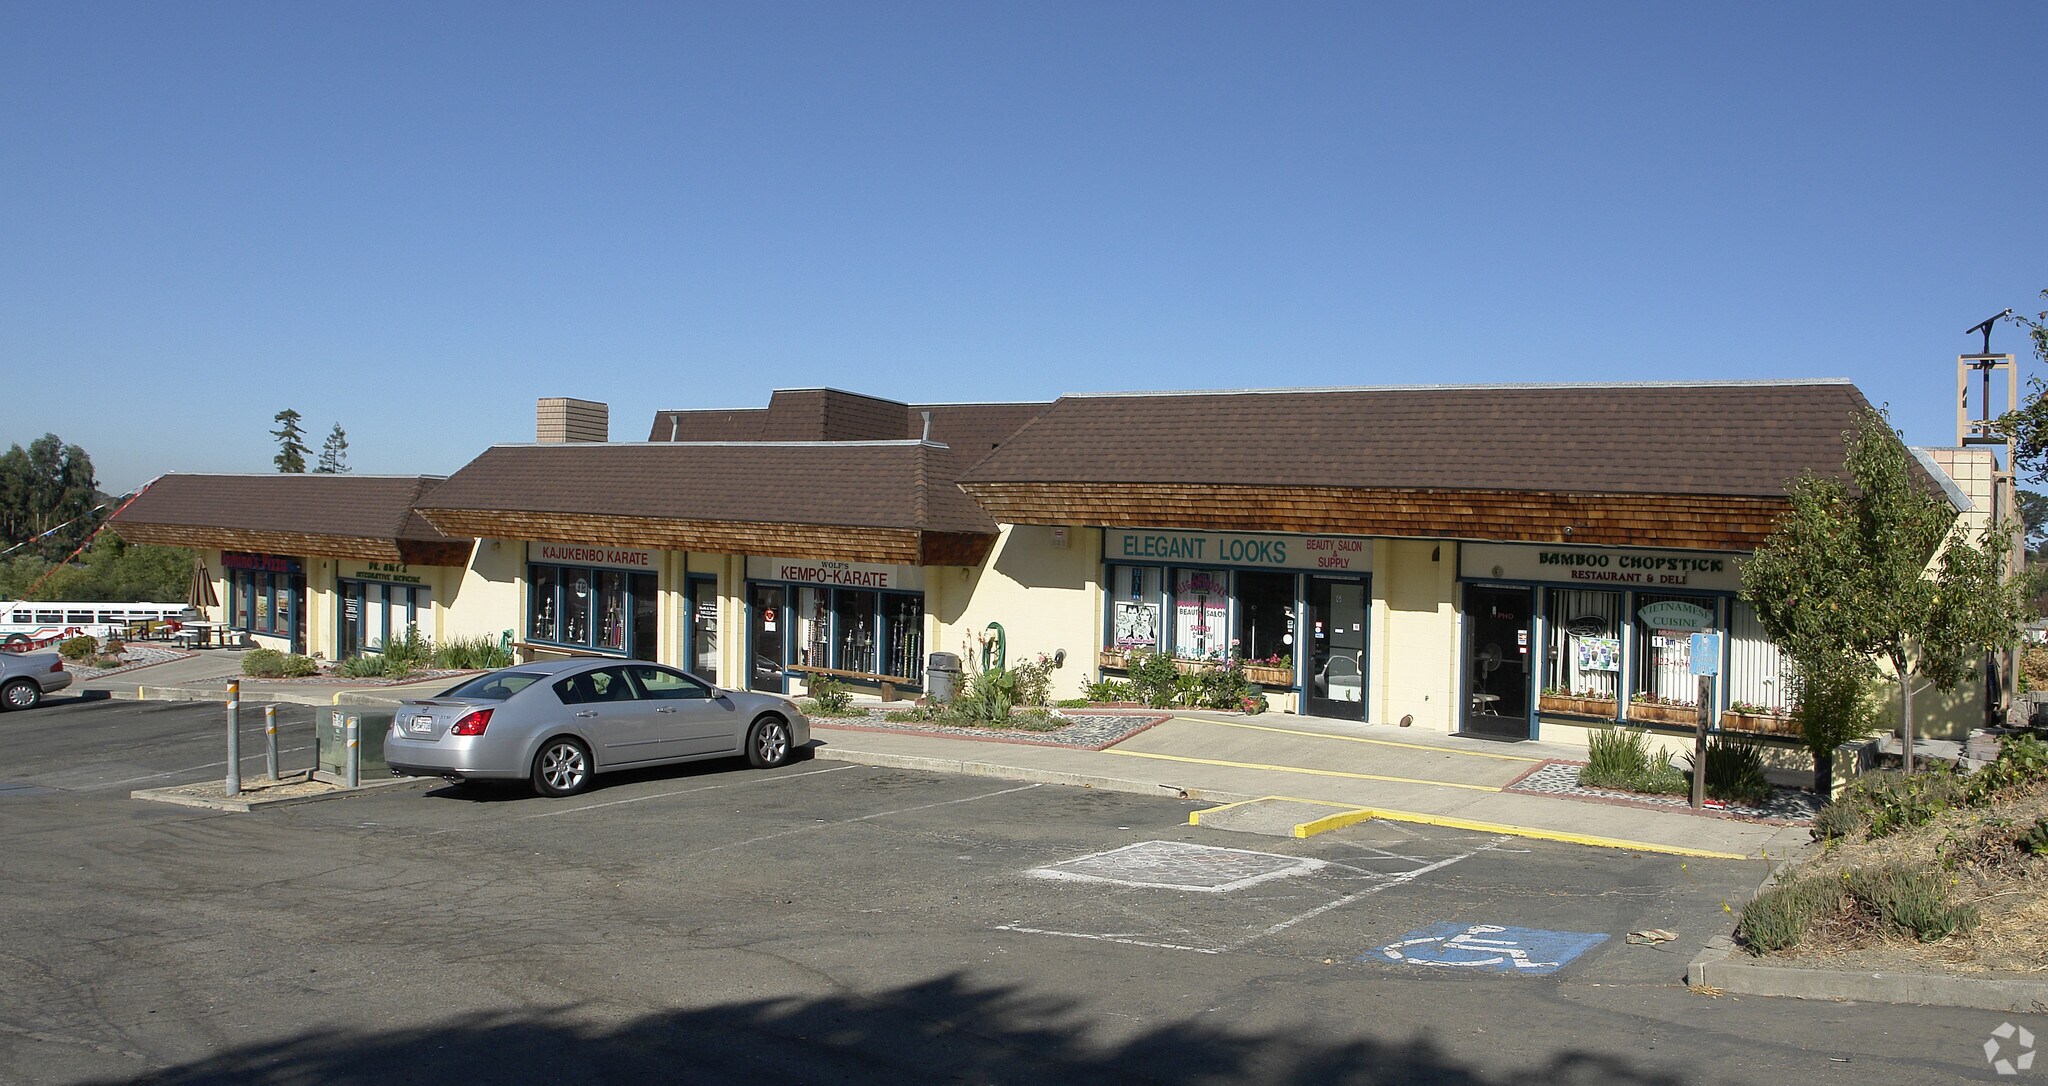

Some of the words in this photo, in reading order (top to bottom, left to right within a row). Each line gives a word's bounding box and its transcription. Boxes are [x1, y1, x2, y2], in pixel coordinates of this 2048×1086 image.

[1123, 535, 1206, 559] ELEGANT
[1219, 538, 1287, 564] LOOKS
[1306, 539, 1335, 551] BEAUTY
[1338, 540, 1362, 552] SALON
[542, 546, 604, 562] KAJUKENBO
[607, 550, 648, 565] KARATE
[1318, 556, 1350, 569] SUPPLY
[1539, 552, 1610, 568] BAMBOO
[1619, 555, 1724, 572] CHOPSTICK
[821, 561, 849, 570] WOLF'S
[780, 565, 888, 587] KEMPO-KARATE
[1571, 569, 1641, 582] RESTAURANT
[1646, 573, 1654, 582] &
[1659, 574, 1687, 585] DELI
[1497, 612, 1514, 620] PHO
[1641, 602, 1711, 620] VIETNAMESE
[1652, 616, 1698, 628] CUISINE
